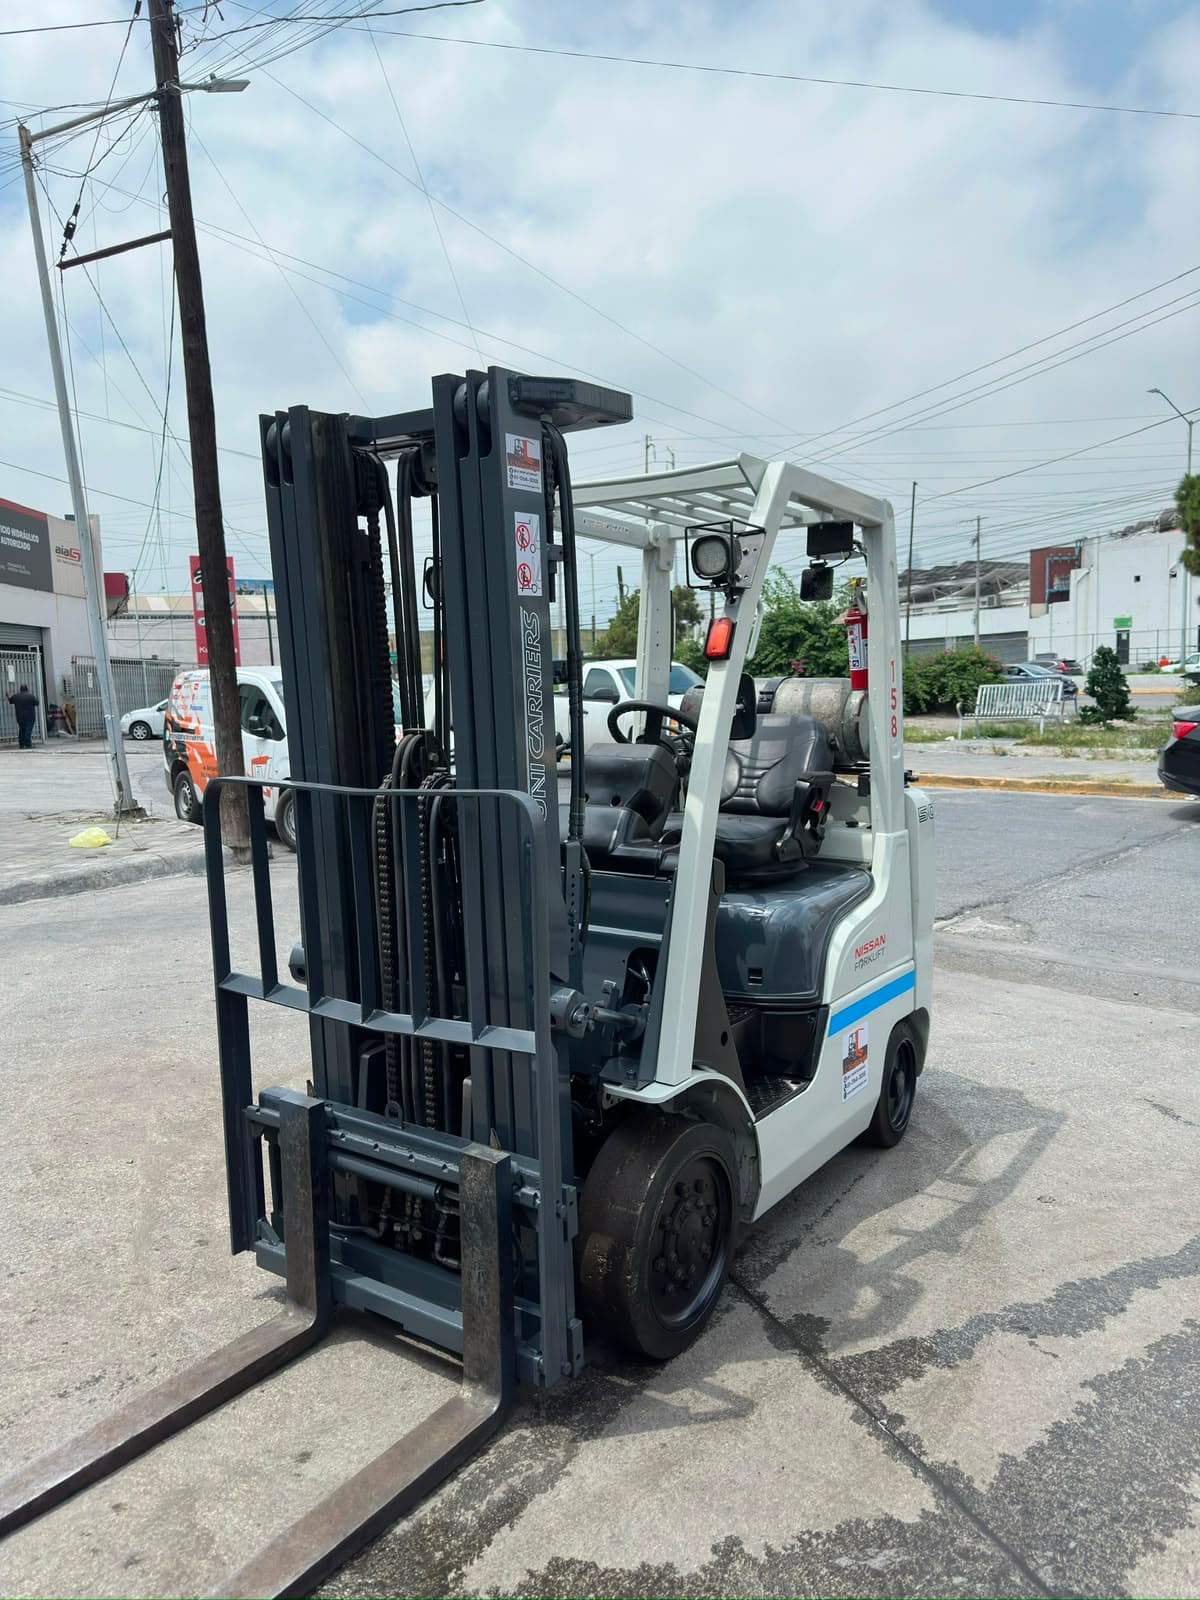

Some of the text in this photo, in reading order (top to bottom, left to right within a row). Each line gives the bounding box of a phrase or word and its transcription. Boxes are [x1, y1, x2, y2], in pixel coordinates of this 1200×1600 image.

[890, 660, 898, 738] 158
[854, 946, 885, 972] FORKLIFT
[855, 934, 886, 959] NISSAN
